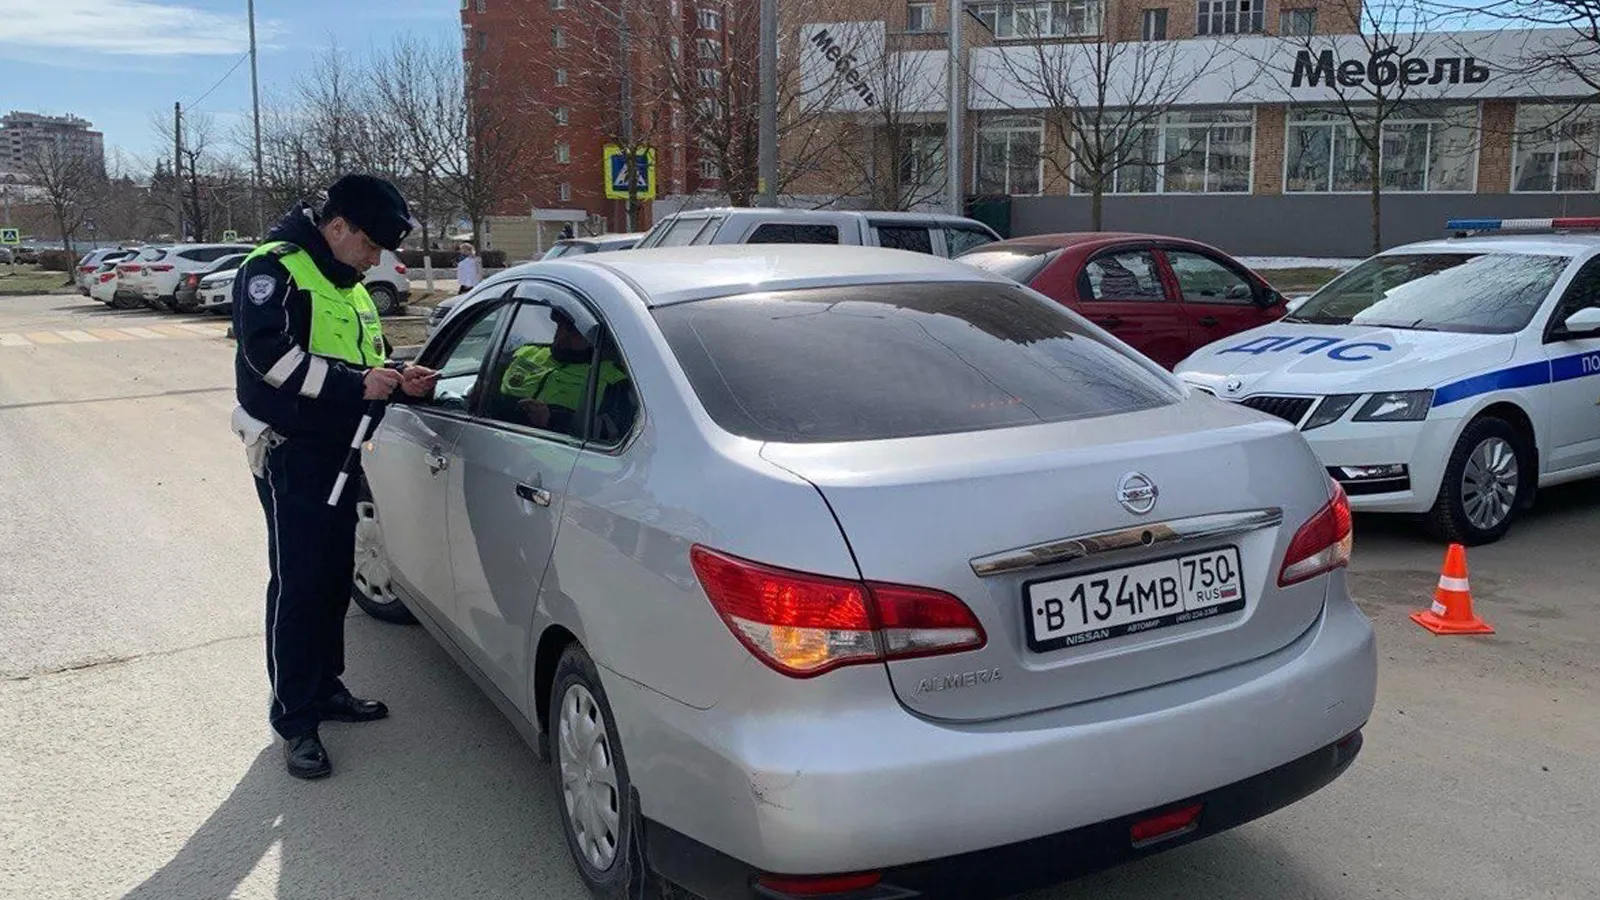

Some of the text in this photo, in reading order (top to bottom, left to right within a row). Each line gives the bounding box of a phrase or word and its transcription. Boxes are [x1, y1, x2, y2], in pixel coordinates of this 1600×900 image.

[811, 28, 874, 107] Мебель
[1291, 46, 1490, 88] Мебель
[1216, 336, 1393, 361] ДПС
[1182, 555, 1231, 591] 750
[1197, 589, 1221, 602] RUS
[1066, 629, 1110, 646] NISSAN
[914, 667, 1002, 694] ALMERA
